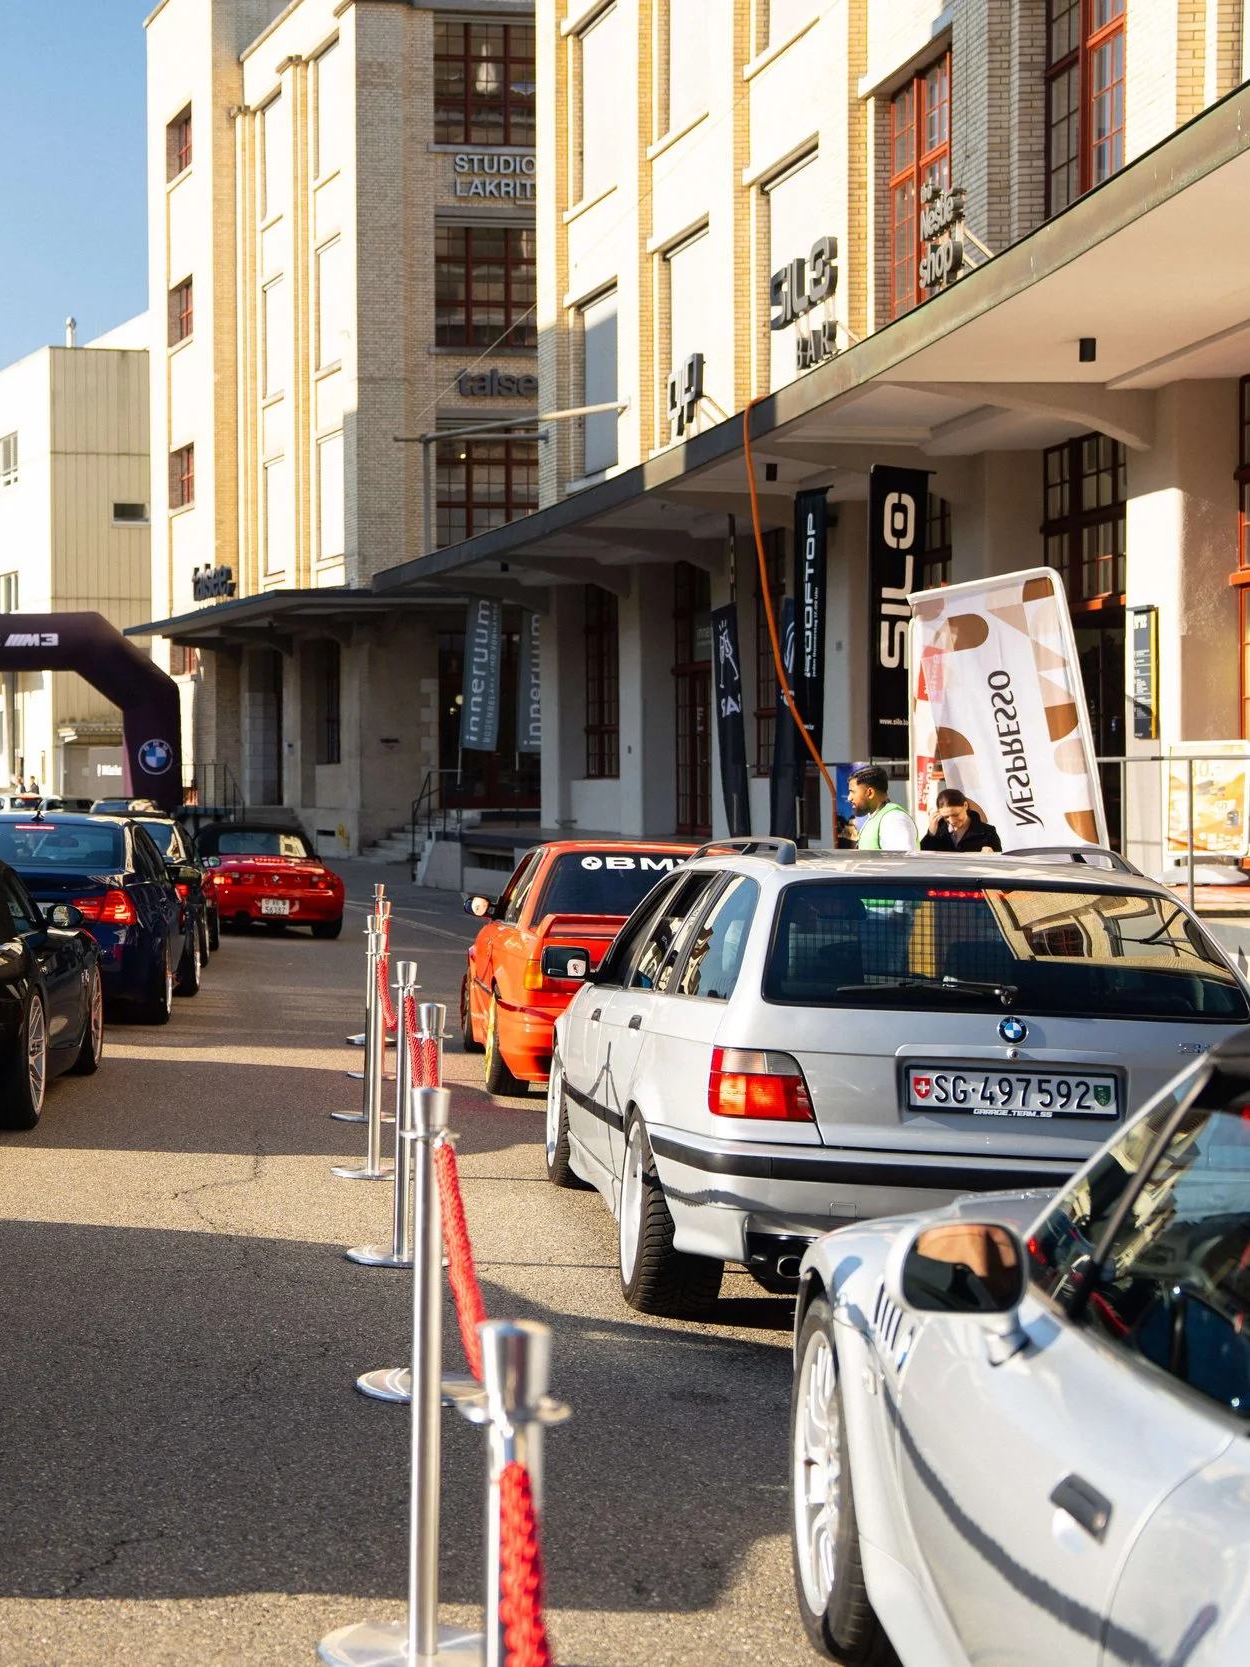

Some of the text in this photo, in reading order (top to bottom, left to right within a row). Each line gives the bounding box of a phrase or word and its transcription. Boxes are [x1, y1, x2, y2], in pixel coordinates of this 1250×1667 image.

[455, 154, 536, 174] STUDIO
[919, 239, 955, 289] shop
[880, 492, 916, 670] SILO
